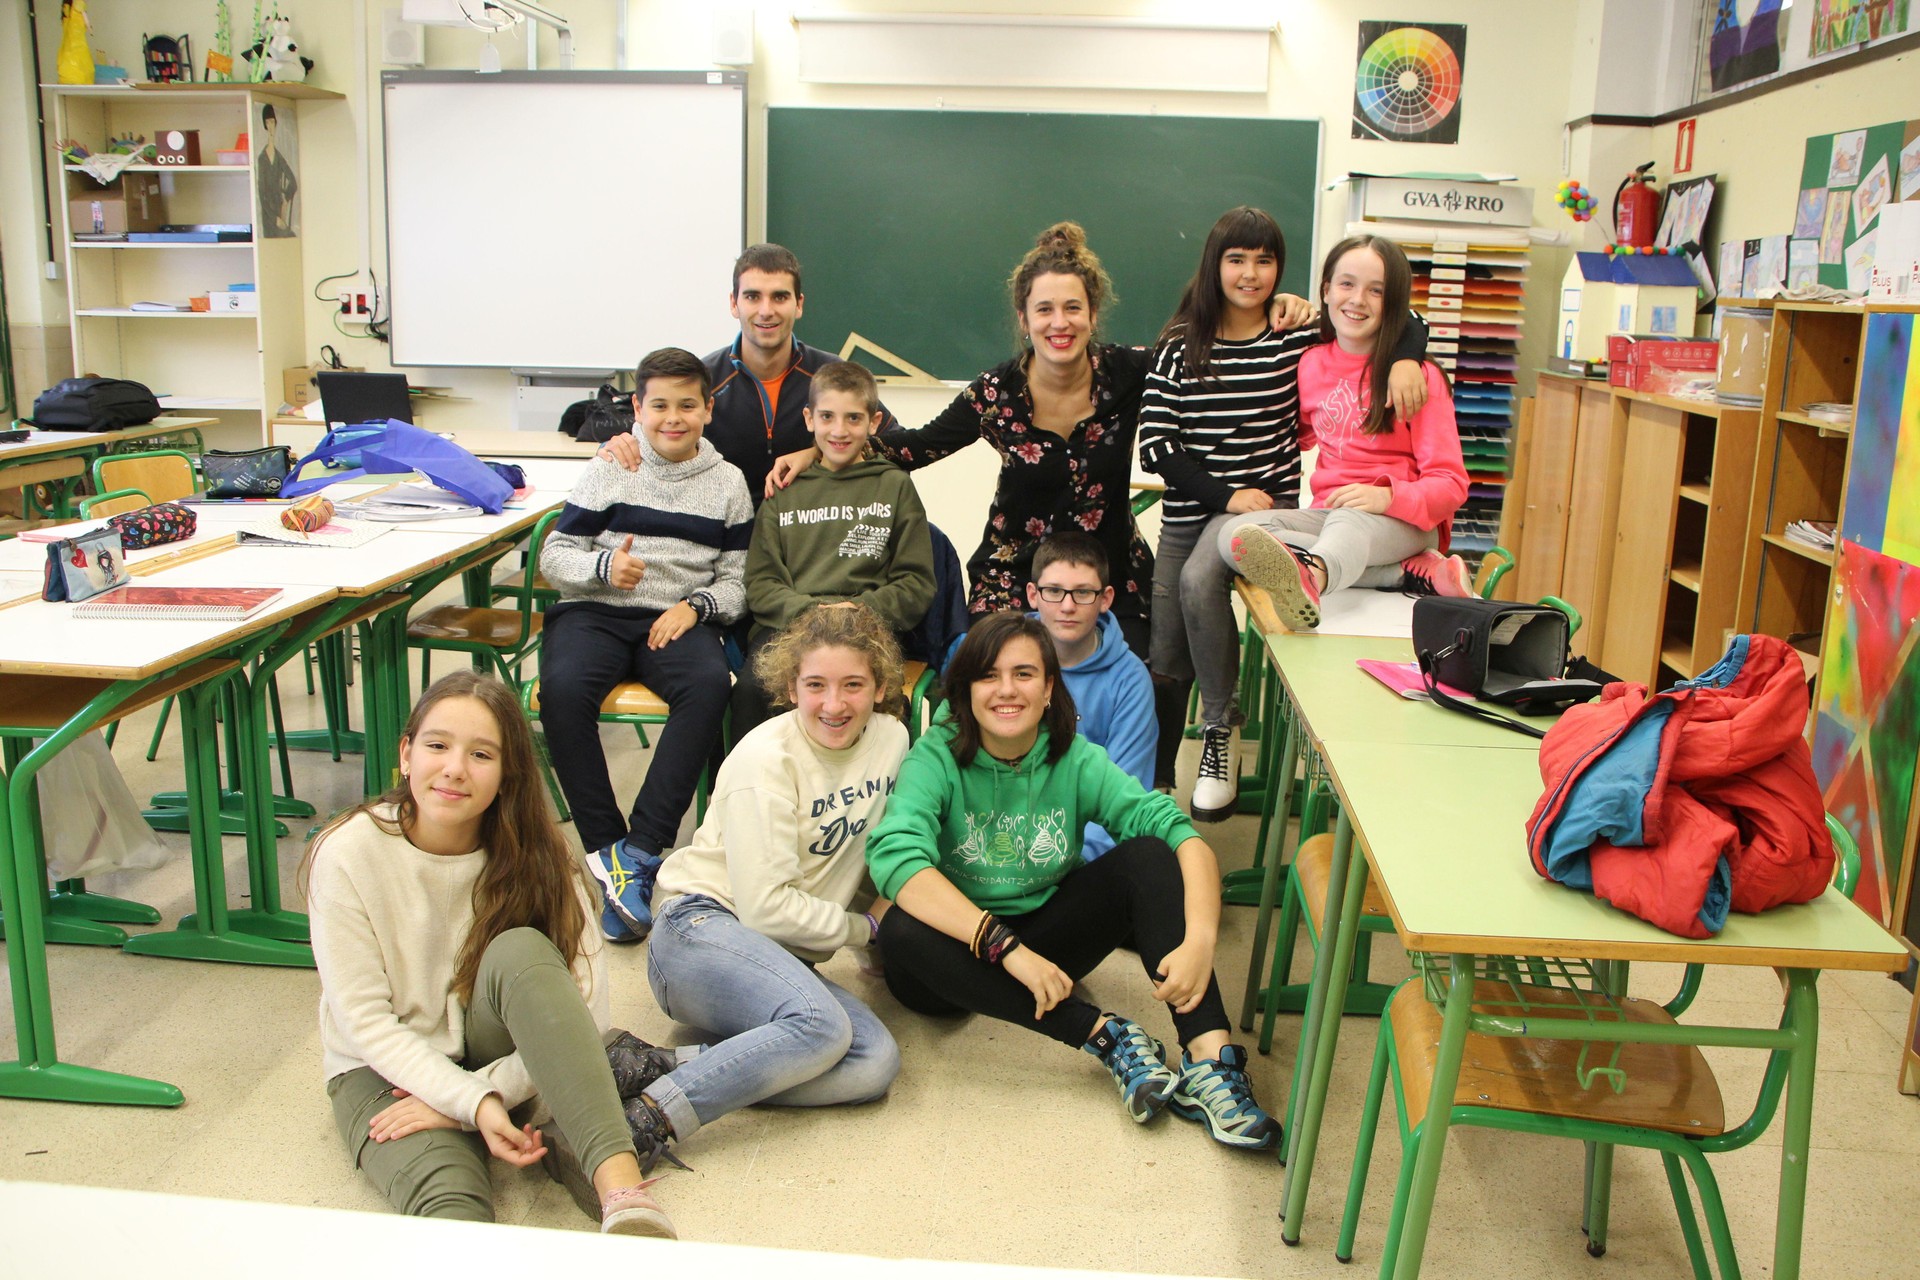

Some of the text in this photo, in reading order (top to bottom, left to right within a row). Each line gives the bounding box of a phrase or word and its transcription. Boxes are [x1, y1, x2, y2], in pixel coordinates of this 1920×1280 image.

[1872, 276, 1891, 287] PLUS
[779, 501, 892, 527] HE WORLD IS YOURS
[808, 816, 868, 856] Da
